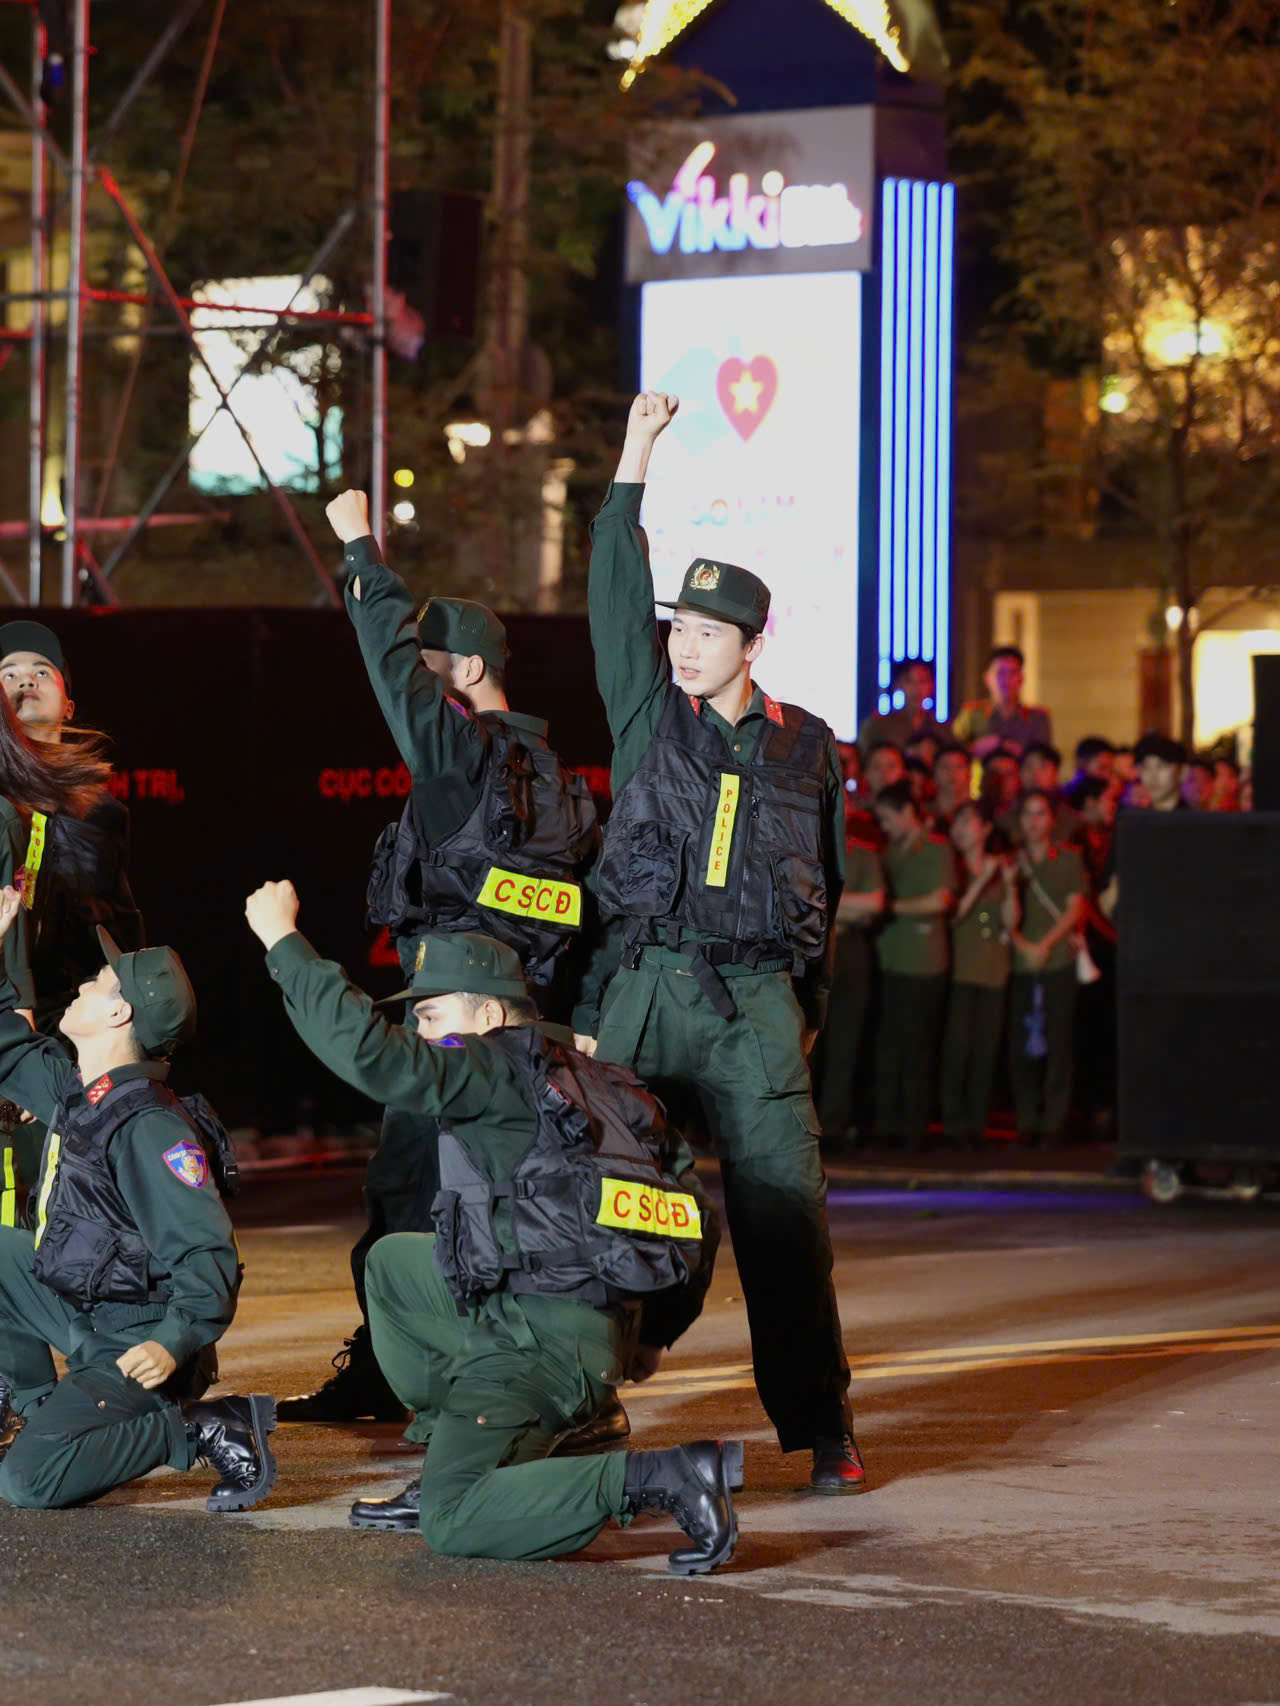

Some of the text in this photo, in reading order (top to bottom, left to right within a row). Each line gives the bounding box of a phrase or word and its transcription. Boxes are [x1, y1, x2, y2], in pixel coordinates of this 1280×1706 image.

[713, 787, 733, 871] POLICE
[494, 877, 572, 915] CSCĐ
[613, 1190, 690, 1228] CSCĐ
